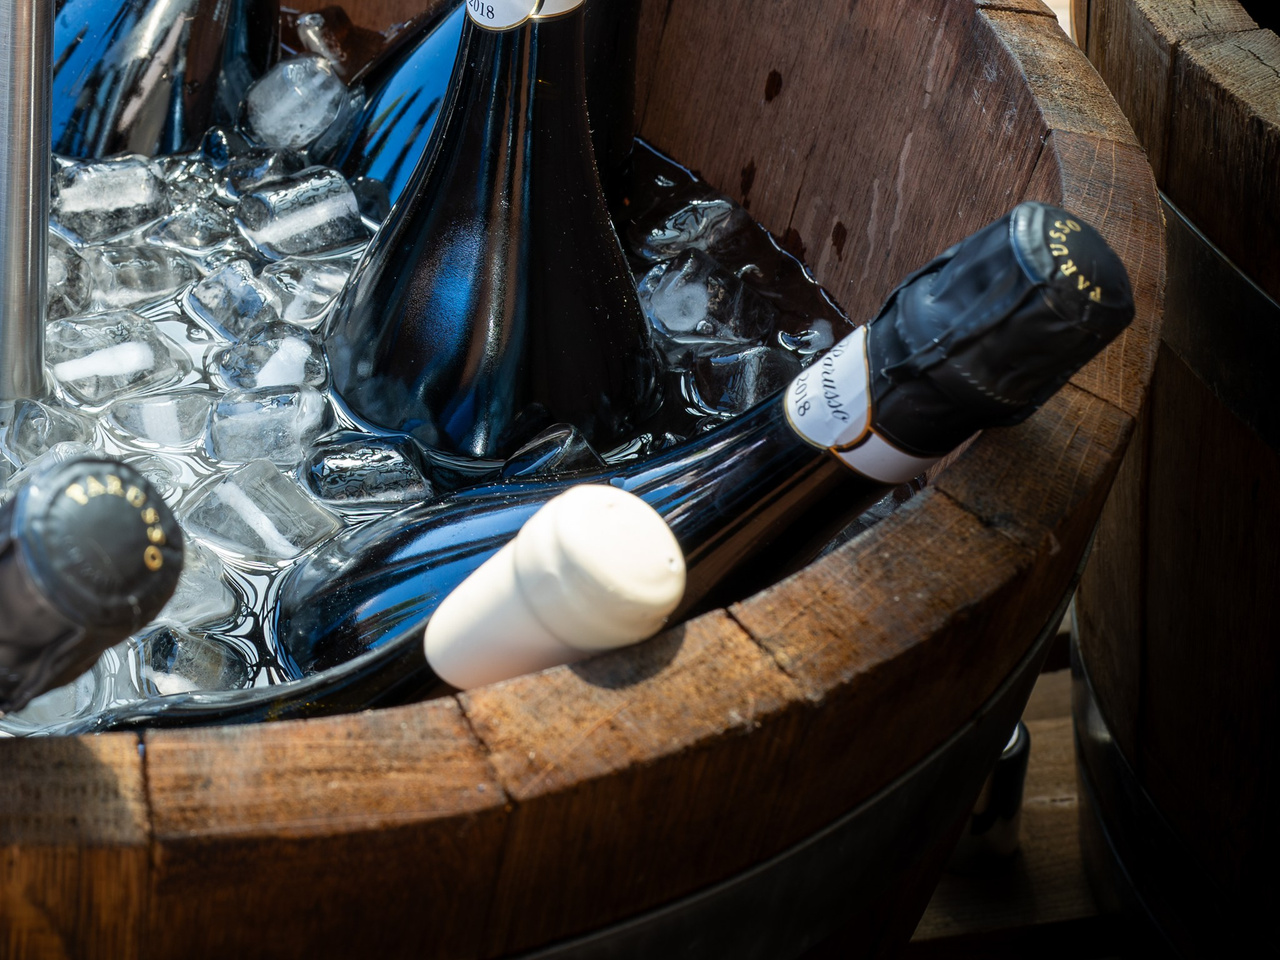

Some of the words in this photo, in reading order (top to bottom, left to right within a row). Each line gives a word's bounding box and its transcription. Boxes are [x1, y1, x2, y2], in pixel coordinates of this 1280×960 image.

[1049, 219, 1102, 303] PARUSSO
[794, 372, 811, 417] 2018
[65, 474, 167, 572] PARUSSO
